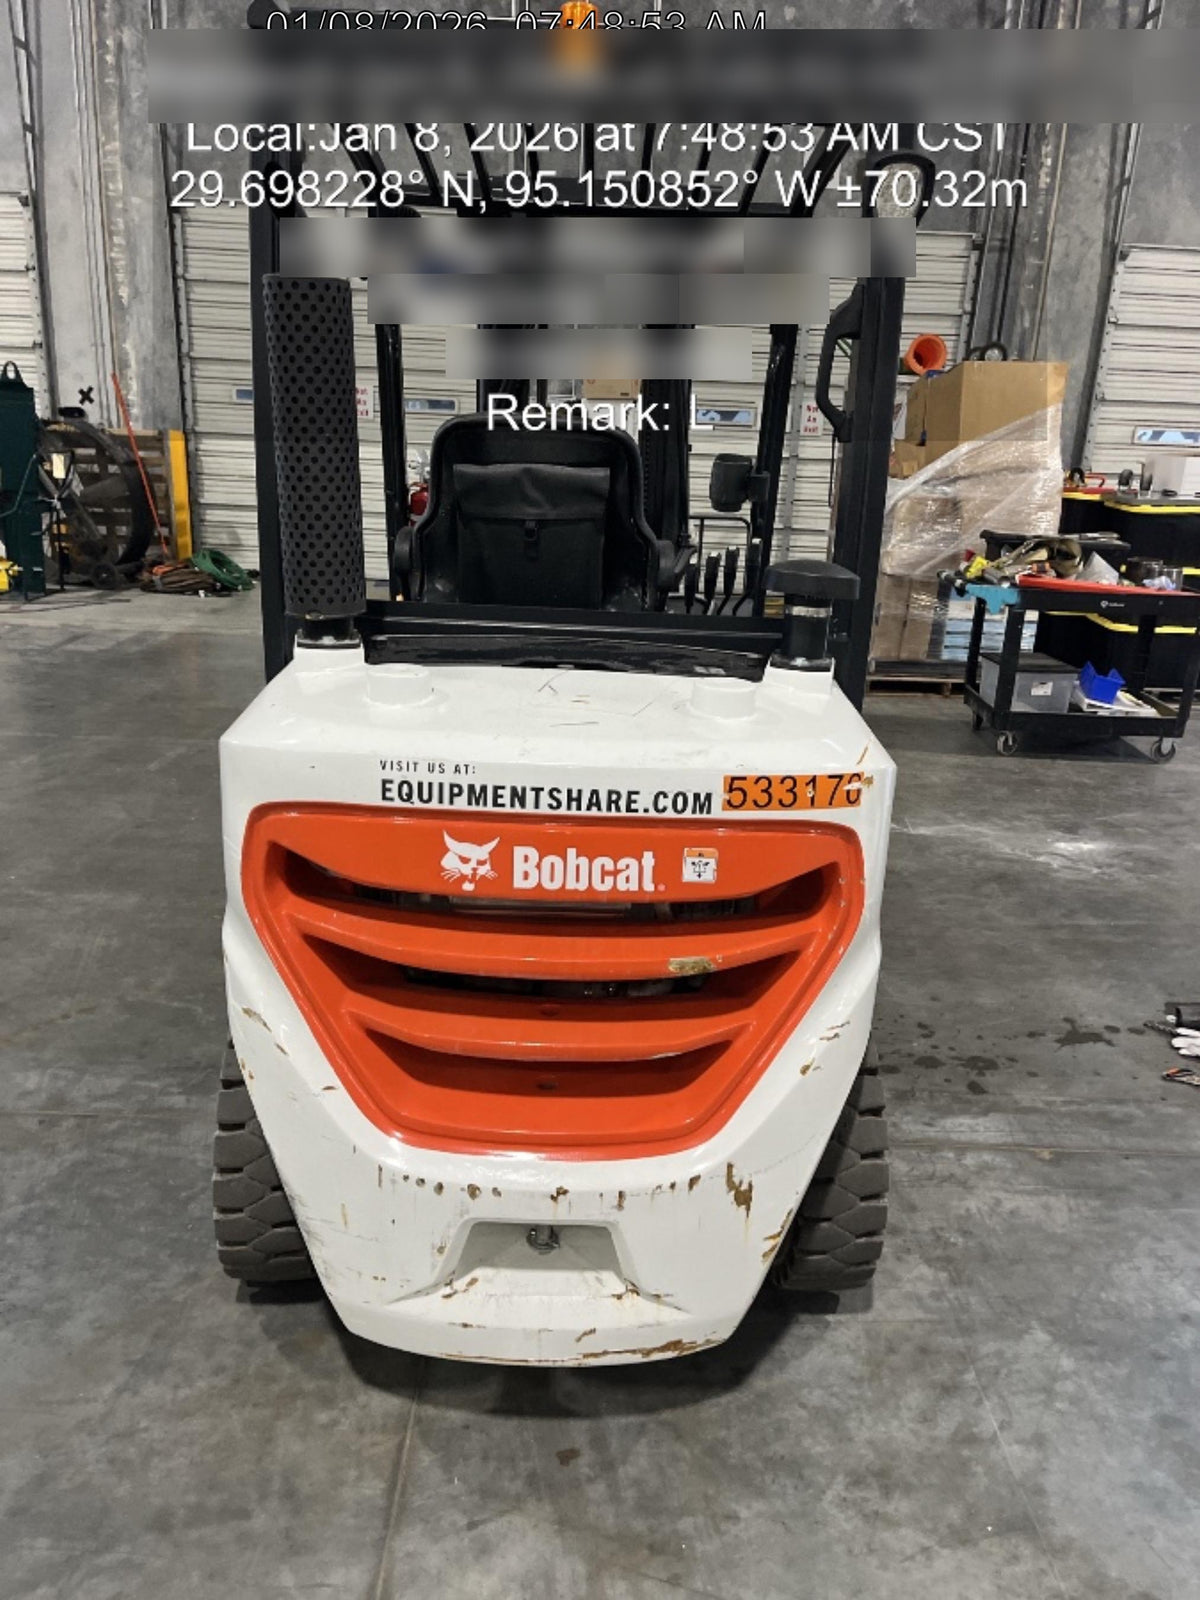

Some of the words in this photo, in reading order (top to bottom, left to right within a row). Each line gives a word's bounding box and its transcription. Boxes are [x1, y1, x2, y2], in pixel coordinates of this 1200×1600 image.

[379, 759, 419, 773] VISIT
[427, 761, 446, 774] US
[453, 763, 476, 776] AT:
[381, 778, 713, 816] EQUIPMENTSHARE.COM
[725, 772, 862, 809] 533170
[513, 846, 656, 892] Bobcat
